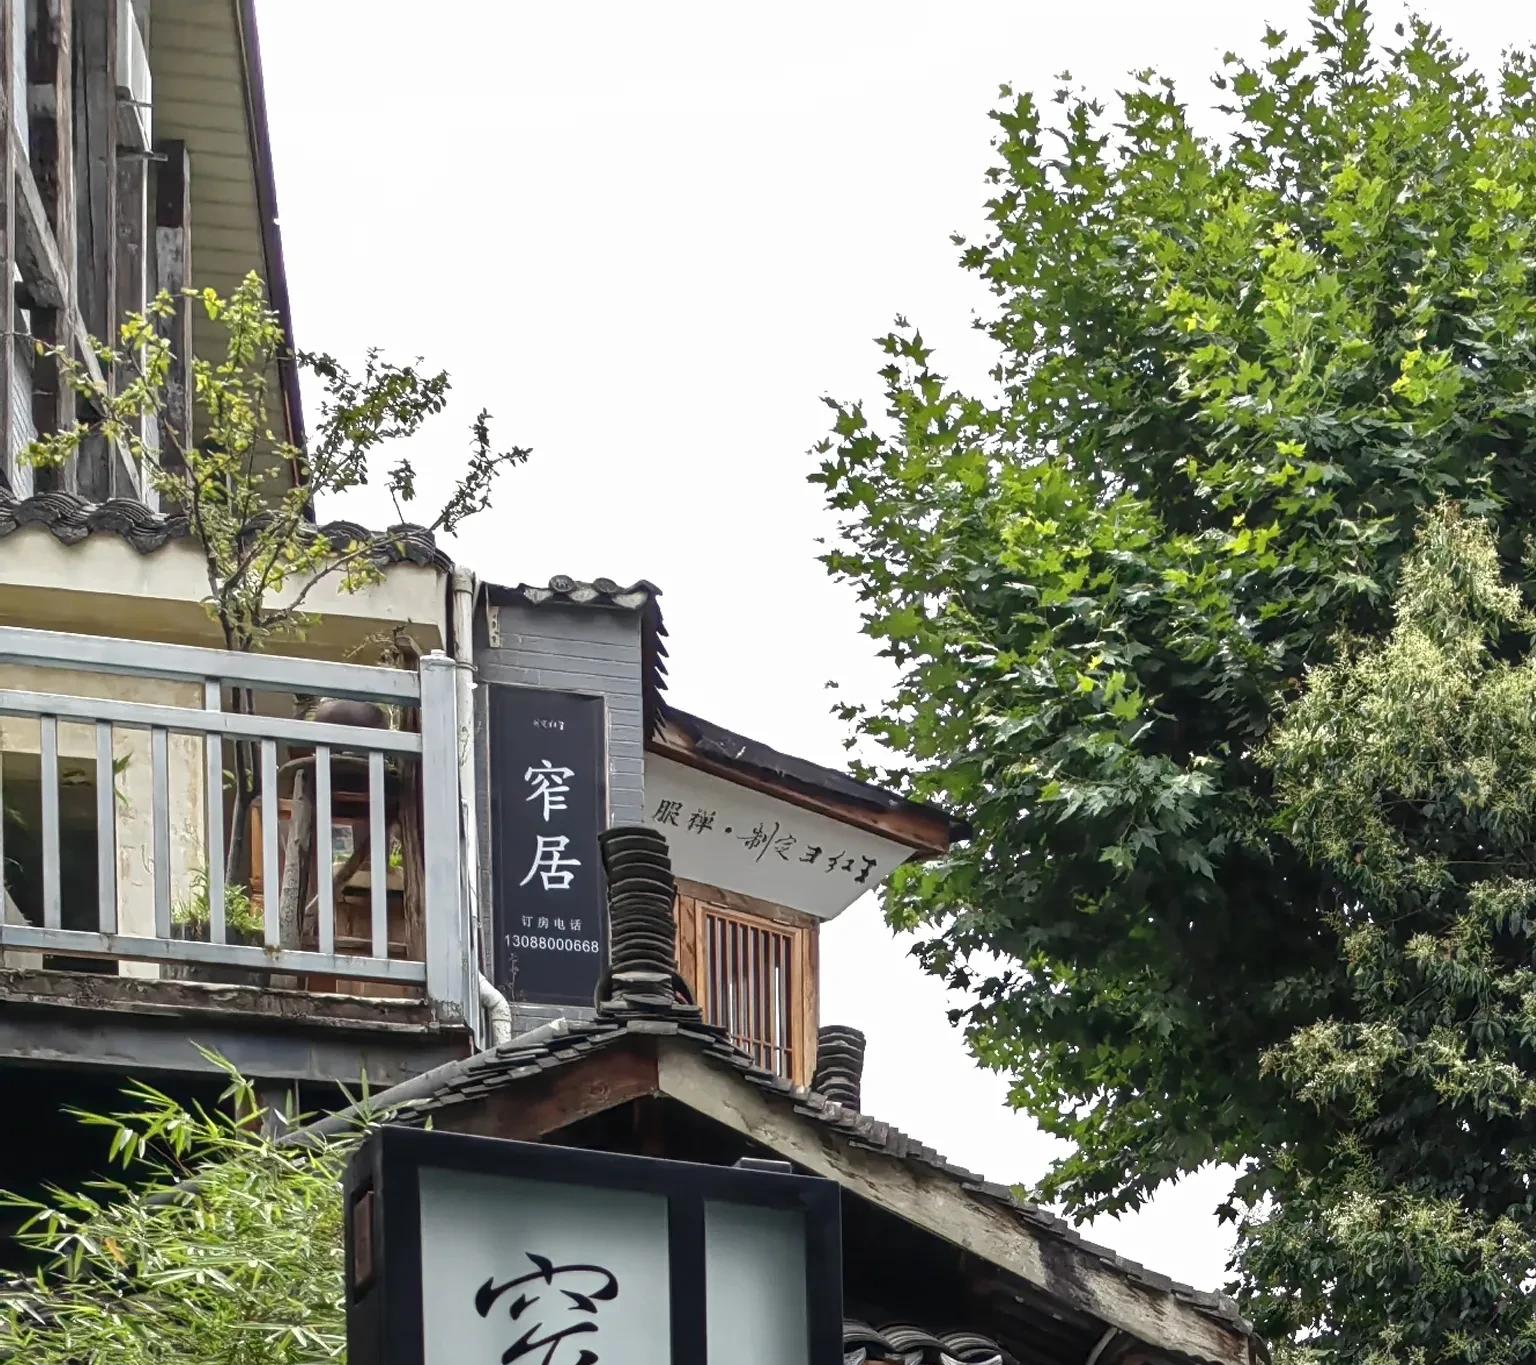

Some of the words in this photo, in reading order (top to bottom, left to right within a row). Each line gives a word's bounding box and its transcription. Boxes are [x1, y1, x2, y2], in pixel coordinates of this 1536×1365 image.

[519, 759, 582, 892] 窄居
[521, 914, 583, 932] 订房电话
[504, 934, 600, 953] 13088000668
